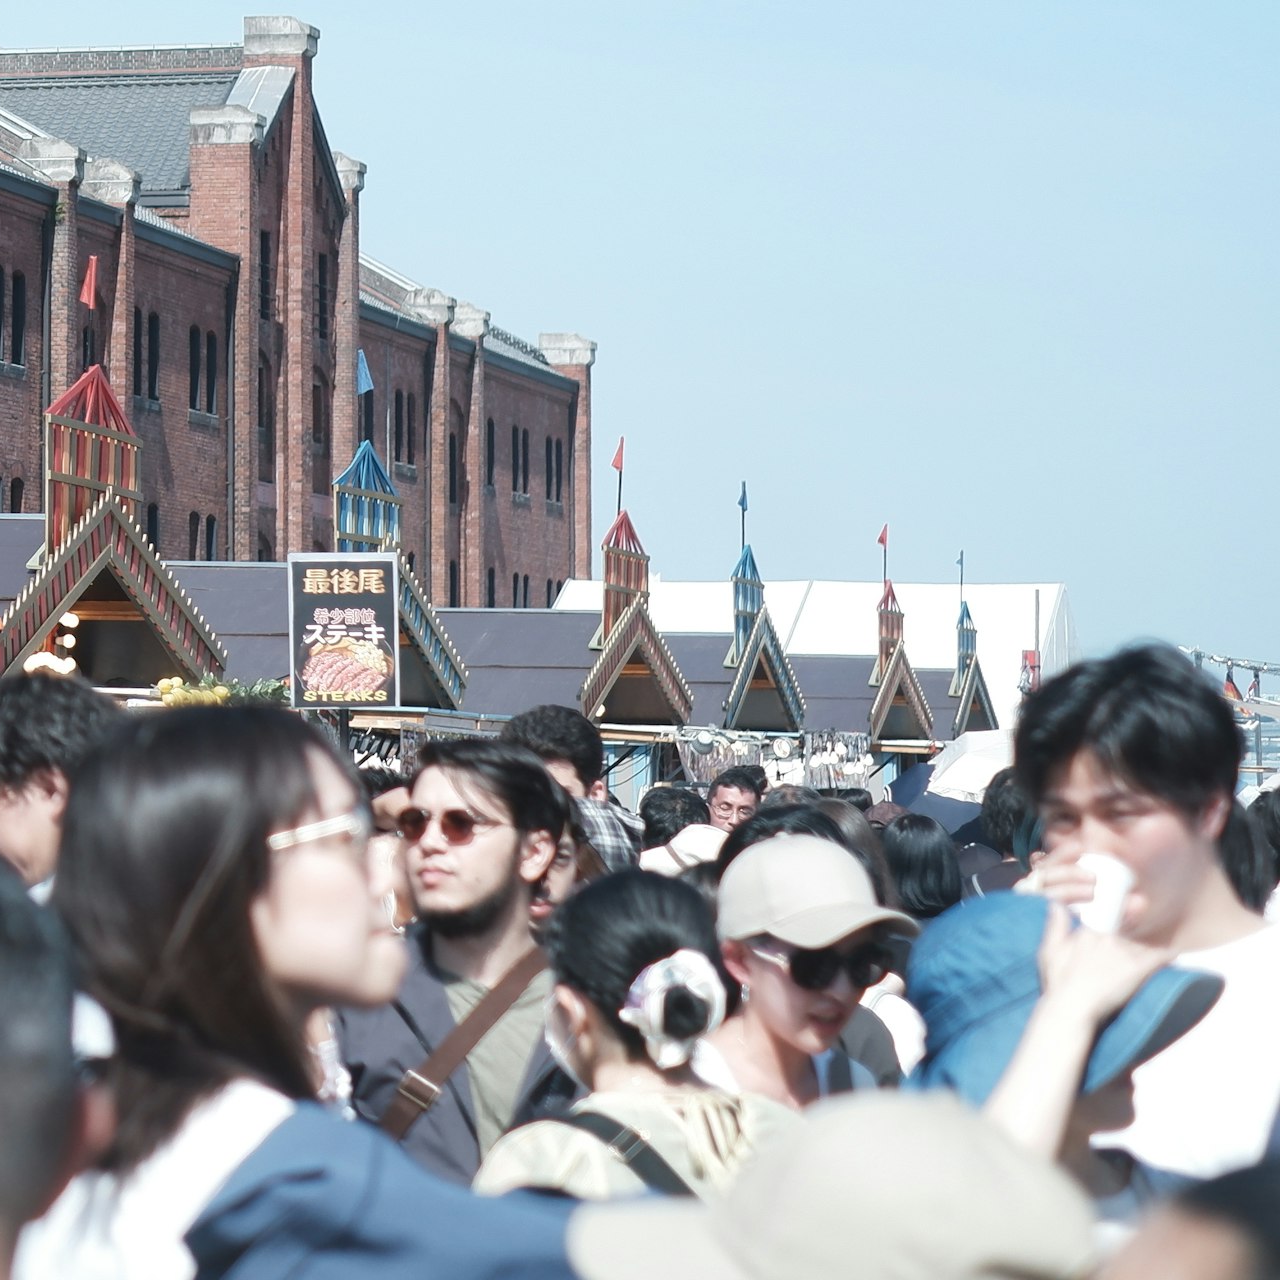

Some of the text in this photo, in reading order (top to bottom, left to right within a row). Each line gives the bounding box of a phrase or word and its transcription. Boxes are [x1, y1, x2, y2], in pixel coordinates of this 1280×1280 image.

[303, 568, 386, 594] 最後尾
[313, 608, 376, 625] 希少部位
[303, 624, 385, 645] ステーキ
[303, 690, 387, 702] STEAKS
